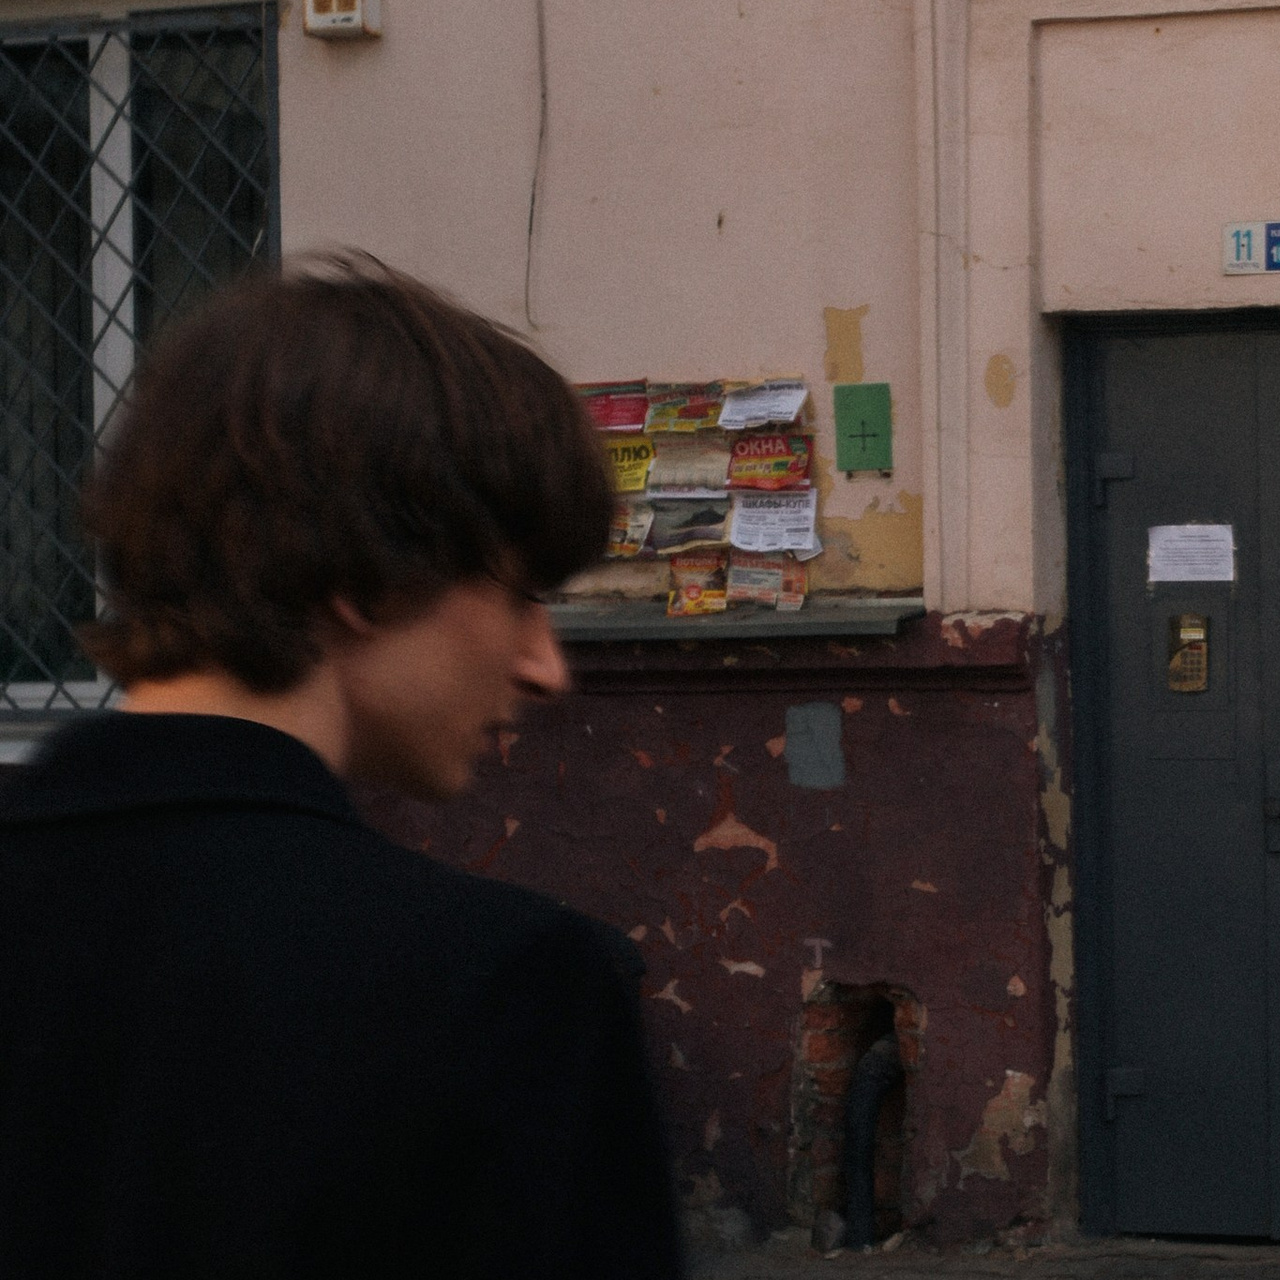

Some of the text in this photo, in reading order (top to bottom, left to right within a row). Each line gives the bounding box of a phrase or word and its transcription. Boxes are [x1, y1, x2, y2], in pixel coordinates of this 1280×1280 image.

[1231, 230, 1252, 261] 11
[735, 438, 786, 455] ОКНА
[742, 500, 811, 509] ШКАФЫ-КУПЕ
